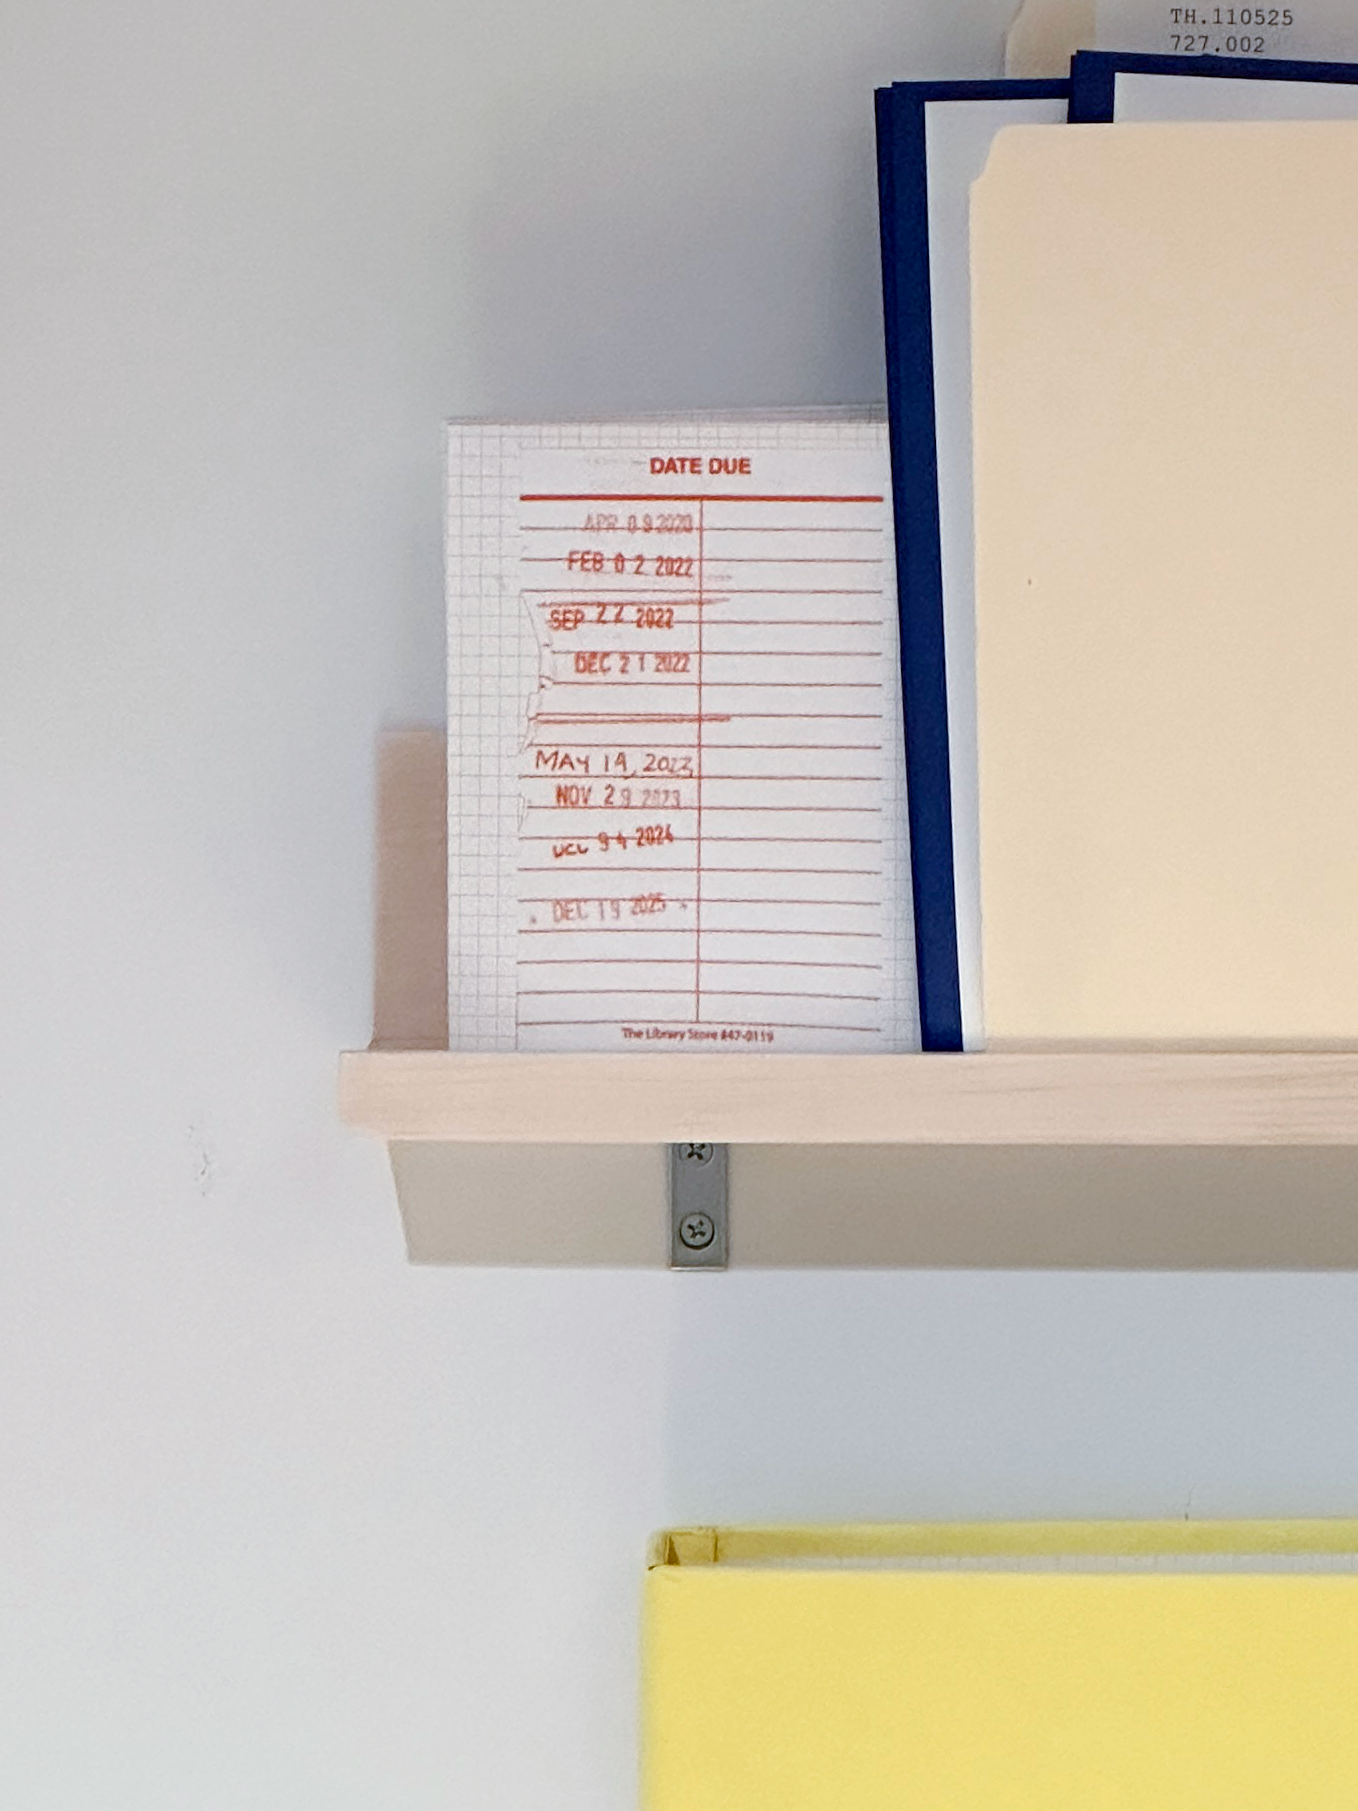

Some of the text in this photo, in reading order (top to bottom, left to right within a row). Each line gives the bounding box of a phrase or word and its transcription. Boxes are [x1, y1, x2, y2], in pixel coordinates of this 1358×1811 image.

[1170, 8, 1293, 26] TH.110525
[1170, 35, 1265, 54] 727.002
[650, 457, 751, 475] DATE DUE
[567, 549, 604, 573] FEB
[655, 554, 693, 578] 2022
[550, 608, 586, 630] SEP
[636, 607, 674, 629] 2022
[574, 651, 611, 674] DEC
[654, 651, 691, 673] 2022
[535, 750, 590, 774] MAY
[556, 785, 592, 807] NOV
[635, 823, 674, 847] 2024
[621, 1026, 644, 1039] The
[646, 1026, 685, 1042] Library
[688, 1027, 718, 1041] Store
